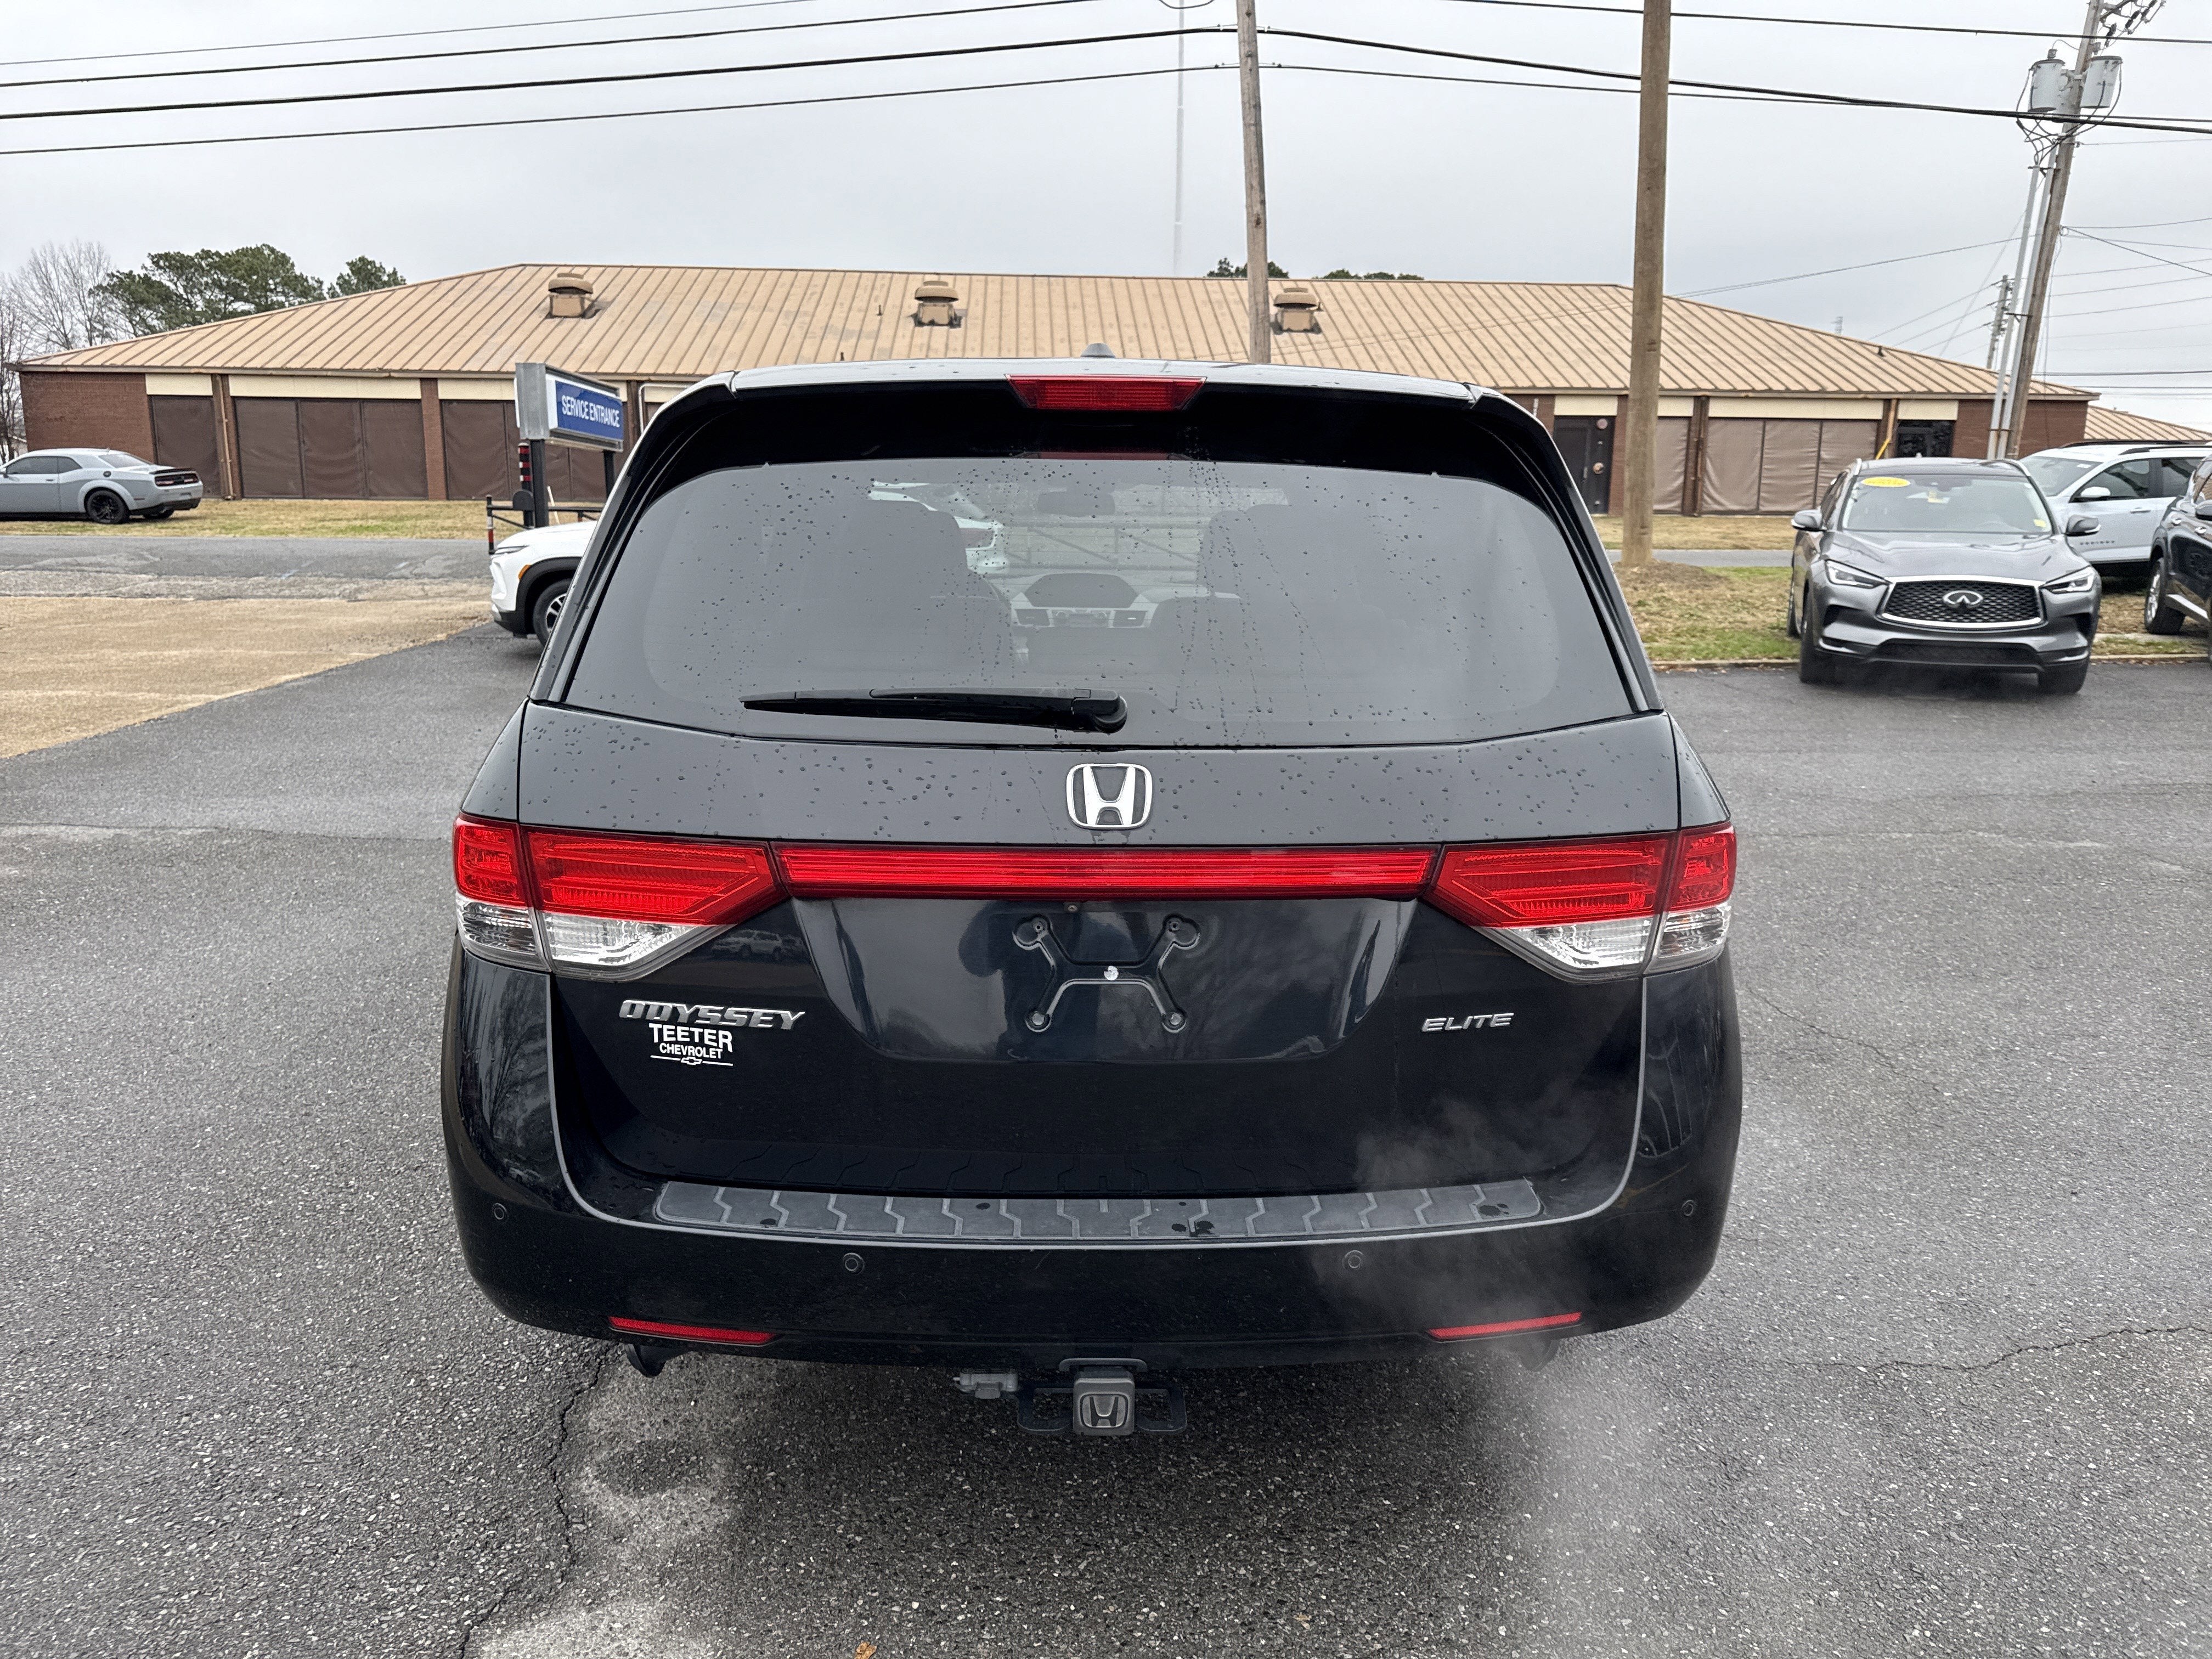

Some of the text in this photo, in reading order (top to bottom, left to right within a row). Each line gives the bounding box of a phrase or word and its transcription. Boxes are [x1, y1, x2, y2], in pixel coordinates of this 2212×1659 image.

[561, 394, 620, 428] SERVICE ENTRANCE
[619, 1000, 805, 1030] ODYSSEY
[1421, 1012, 1514, 1032] ELITE
[648, 1023, 733, 1053] TEETER
[659, 1042, 723, 1059] CHEVROLET
